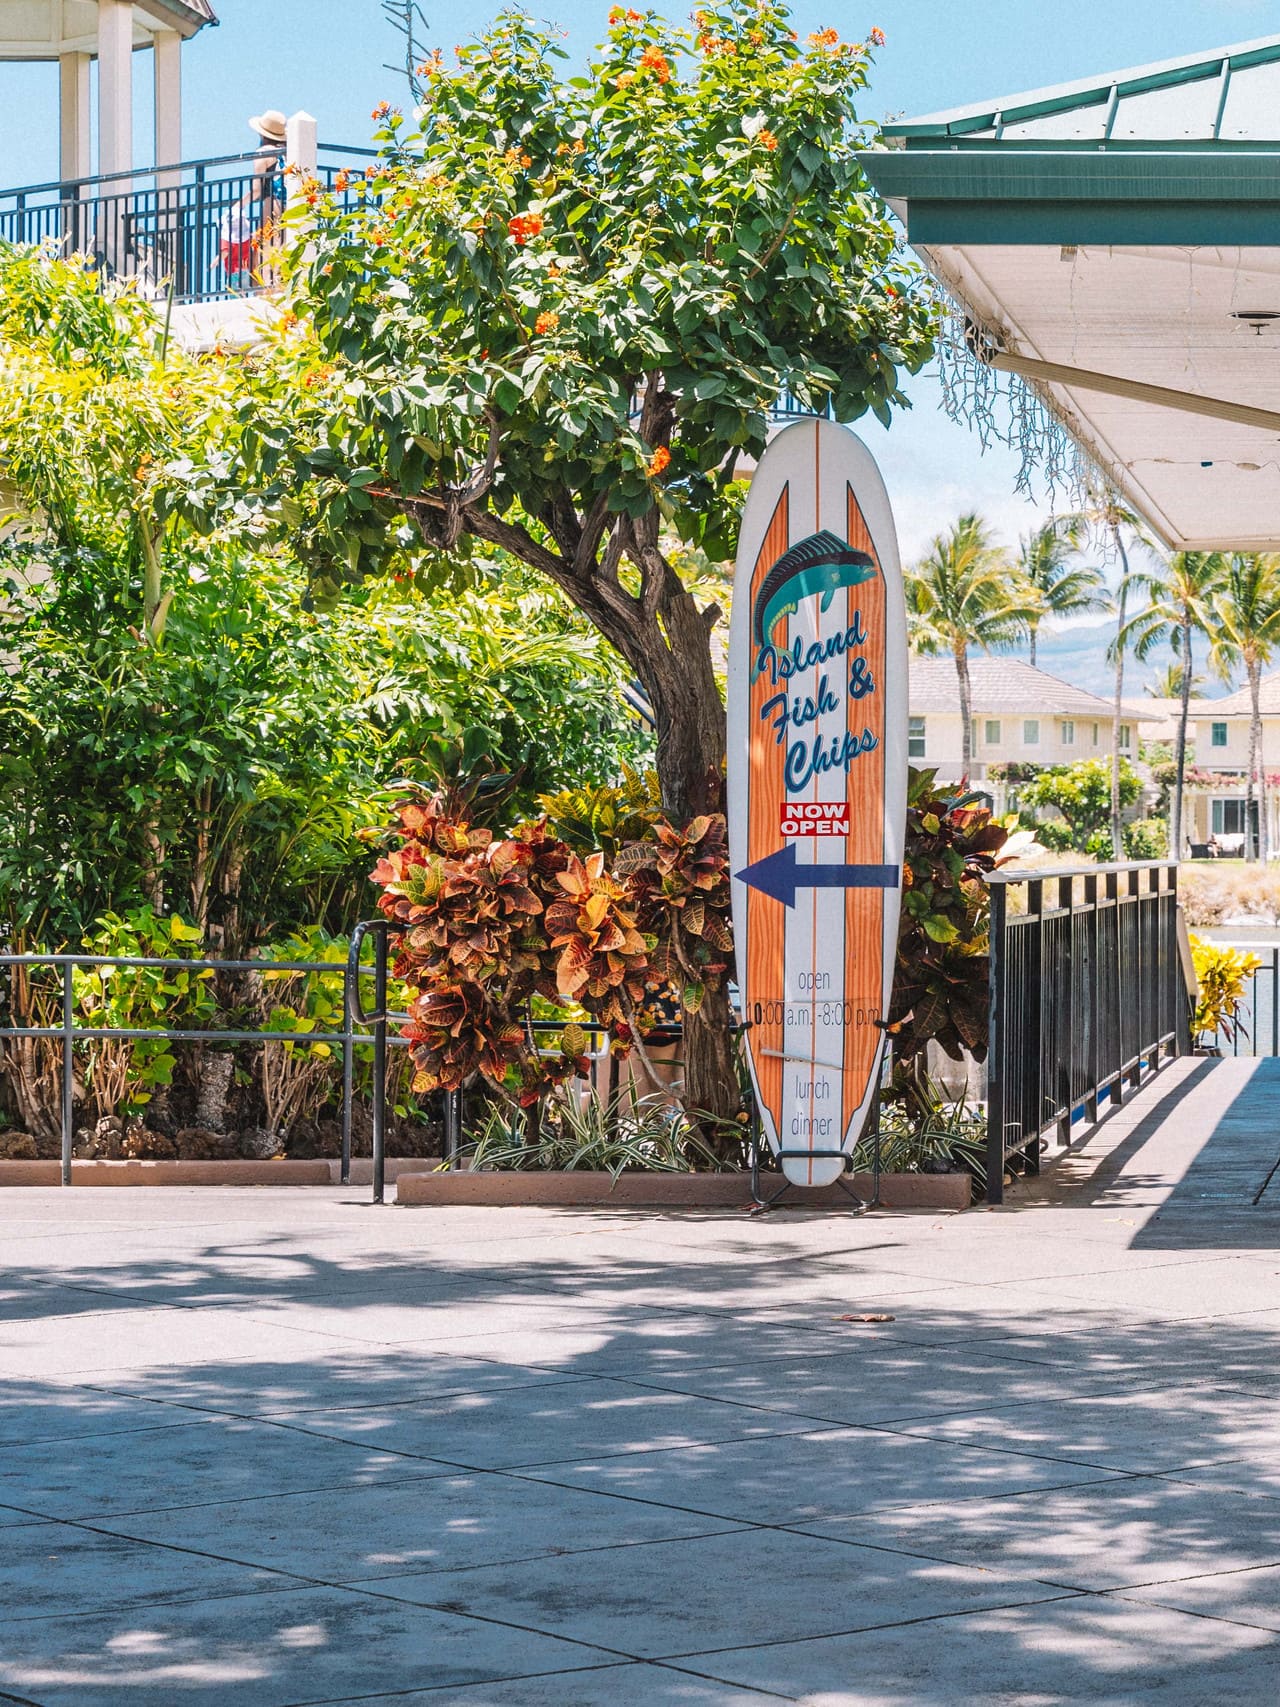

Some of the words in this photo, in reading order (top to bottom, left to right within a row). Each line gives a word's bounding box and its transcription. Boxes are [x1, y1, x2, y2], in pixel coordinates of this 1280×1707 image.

[758, 610, 866, 685] Island
[761, 674, 839, 744] Fish
[849, 656, 875, 700] &
[783, 728, 879, 794] Chips
[786, 805, 846, 818] NOW
[781, 821, 850, 834] OPEN
[798, 972, 830, 993] open
[787, 1009, 813, 1026] a.m.
[856, 1008, 882, 1030] p.m
[795, 1075, 830, 1099] lunch
[791, 1112, 833, 1136] dinner
